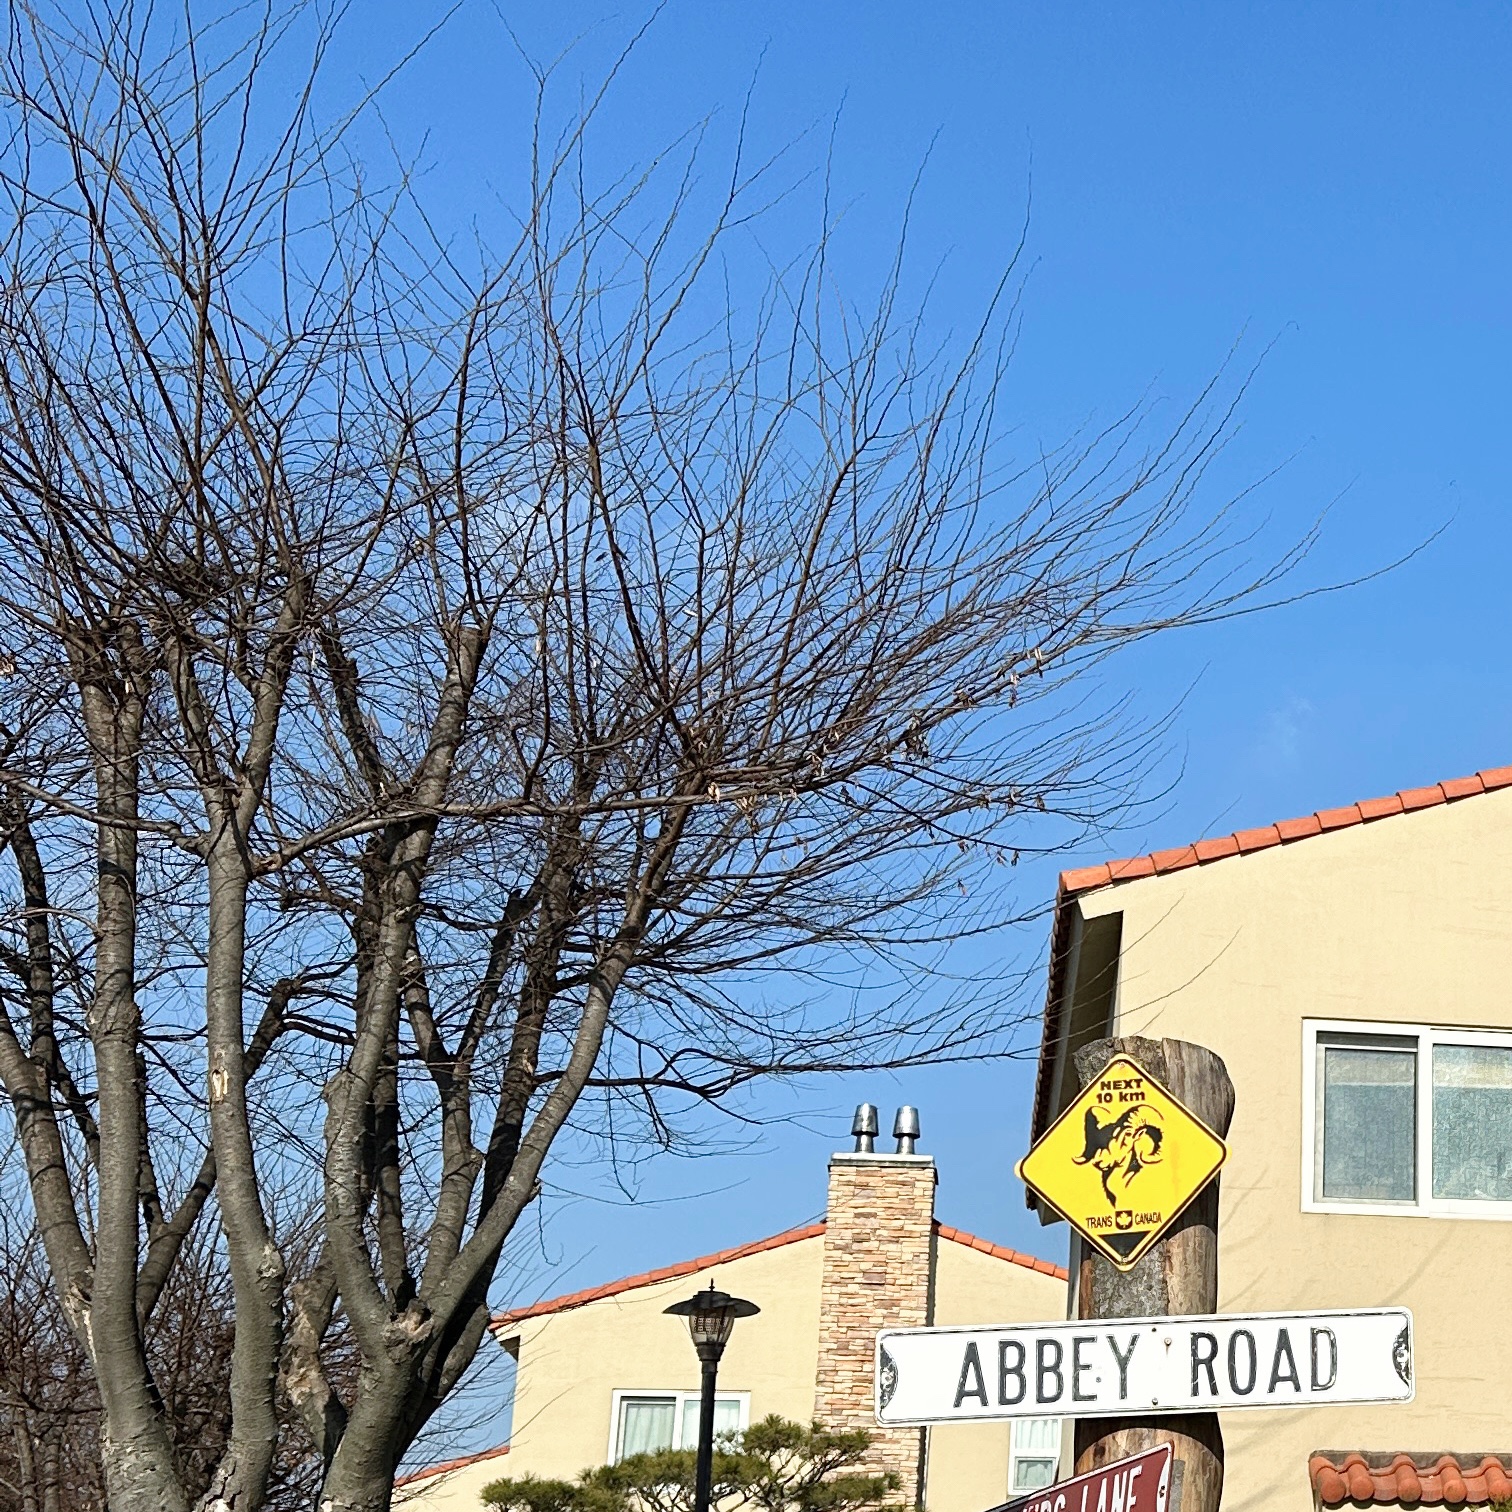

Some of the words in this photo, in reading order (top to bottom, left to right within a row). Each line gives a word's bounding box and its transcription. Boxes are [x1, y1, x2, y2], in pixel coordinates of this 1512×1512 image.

[1100, 1078, 1143, 1091] NEXT
[1096, 1092, 1113, 1104] 10
[1119, 1091, 1146, 1103] km
[1086, 1215, 1113, 1230] TRANS
[1135, 1211, 1162, 1226] CANADA
[953, 1333, 1140, 1408] ABBEY
[1189, 1326, 1338, 1399] ROAD
